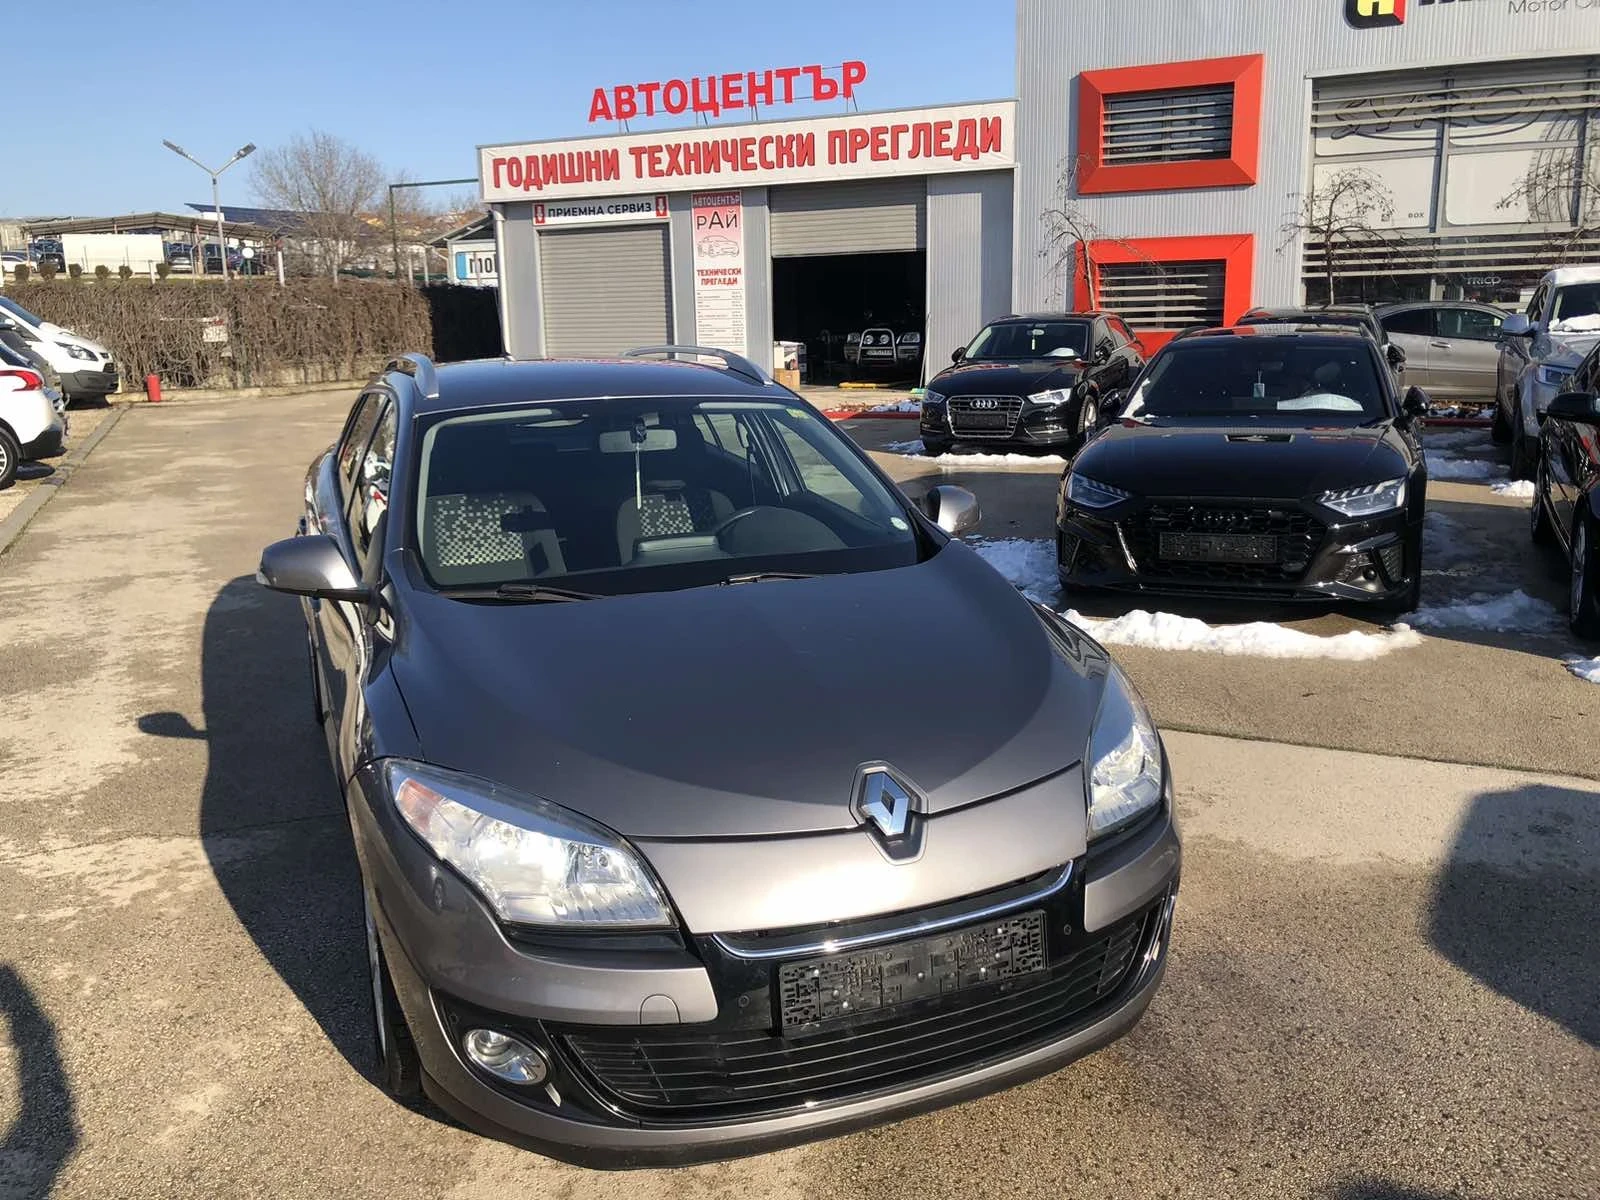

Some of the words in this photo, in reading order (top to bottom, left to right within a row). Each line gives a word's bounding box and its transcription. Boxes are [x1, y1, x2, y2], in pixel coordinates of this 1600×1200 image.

[588, 61, 866, 121] АВТОЦЕНТЪР
[492, 149, 620, 191] ГОДИШНИ
[629, 133, 815, 179] ТЕХНИЧЕСКИ
[827, 115, 1002, 165] ПРЕГЛЕДИ
[693, 194, 740, 207] АВТОЦЕНТЪР
[547, 205, 605, 218] ПРИЕМНА
[607, 202, 652, 215] СЕРВИЗ
[696, 267, 742, 277] ТЕХНИЧЕСКИ
[701, 278, 737, 286] ПРЕГЛЕДИ
